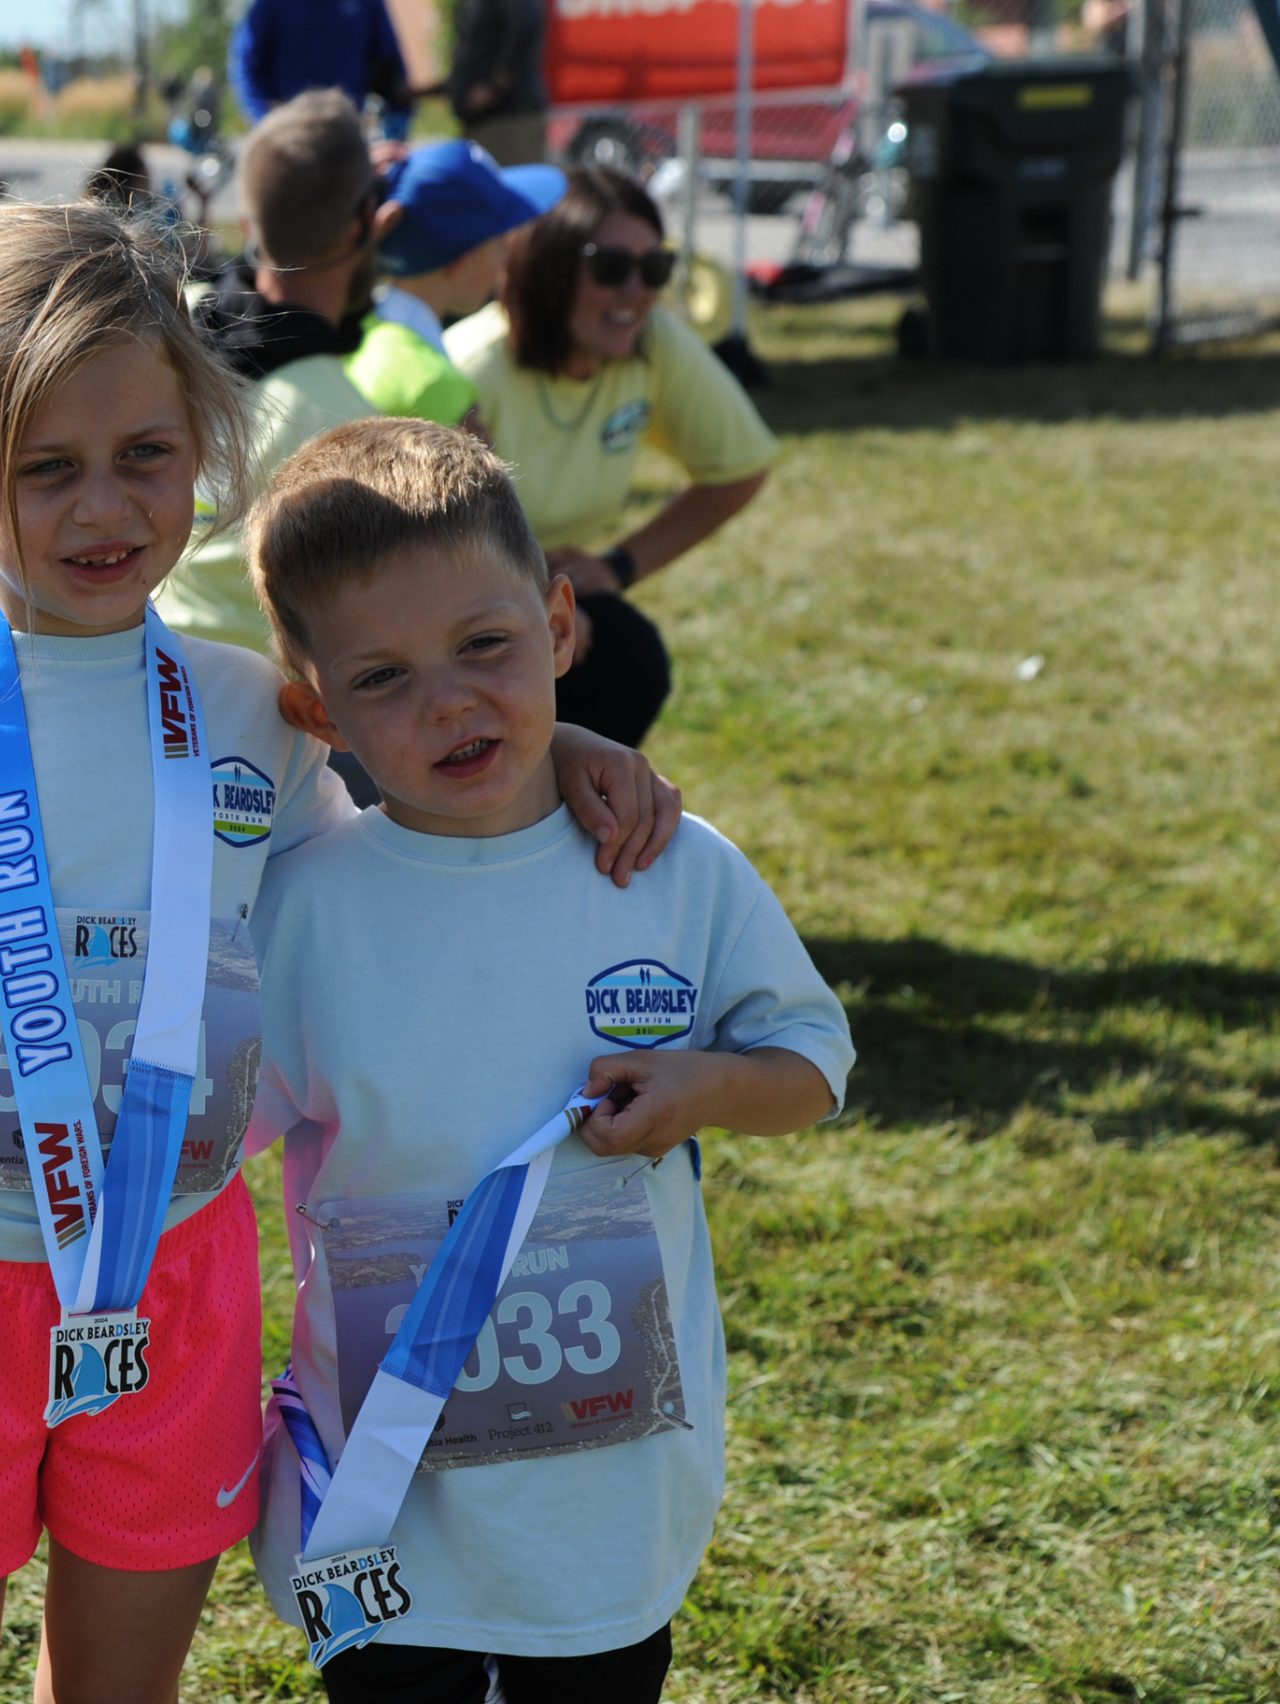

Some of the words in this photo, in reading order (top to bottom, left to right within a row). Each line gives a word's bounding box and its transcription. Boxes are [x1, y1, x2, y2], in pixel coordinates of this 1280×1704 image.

[155, 647, 188, 745] VFW
[76, 916, 97, 924] DICK
[70, 979, 120, 1004] UTH
[585, 988, 620, 1014] DICK
[78, 1146, 91, 1178] FOREIGN
[34, 1122, 84, 1234] VFW
[447, 1199, 465, 1208] DICK
[56, 1327, 84, 1343] DICK
[87, 1321, 149, 1340] BEARDSLEY
[570, 1388, 635, 1420] VFW
[445, 1433, 477, 1446] Health
[488, 1425, 531, 1441] Project
[533, 1422, 554, 1433] 412
[292, 1570, 326, 1591] DICK
[326, 1548, 396, 1581] BEARDSLEY
